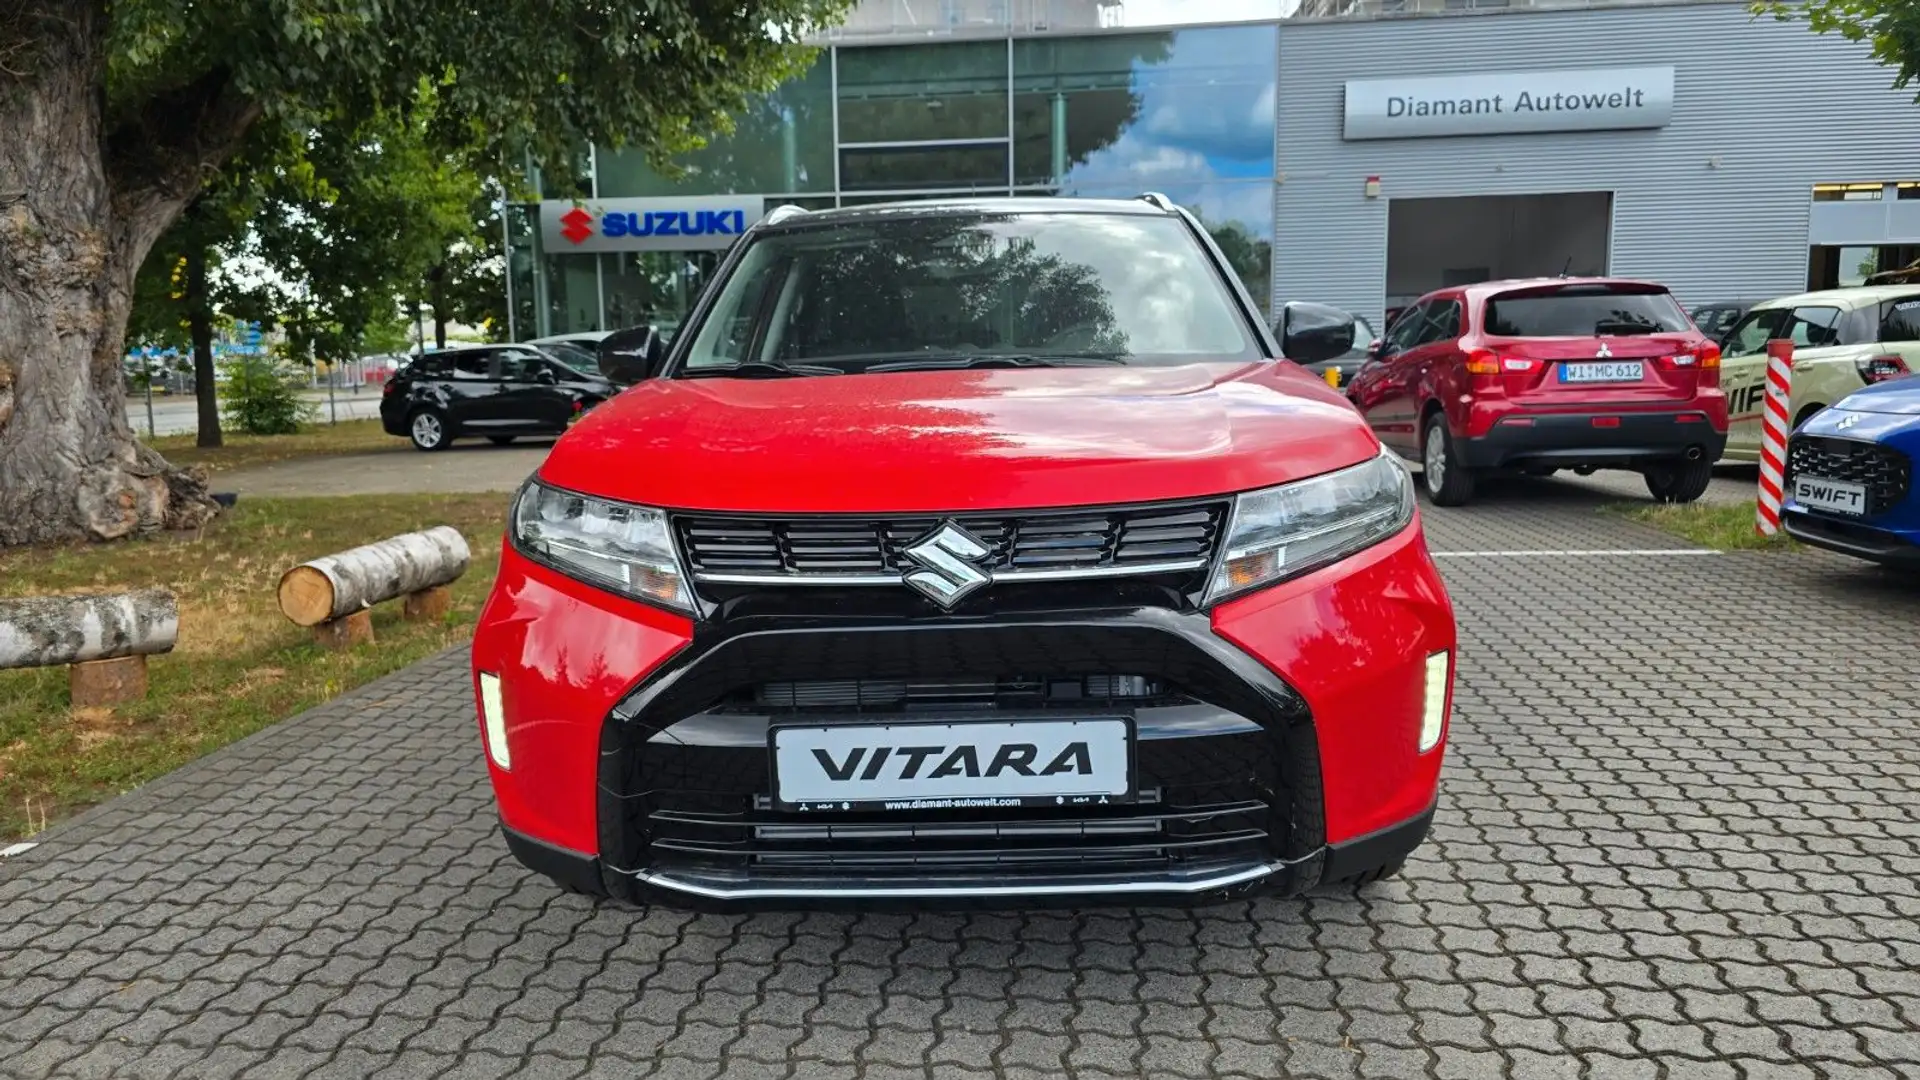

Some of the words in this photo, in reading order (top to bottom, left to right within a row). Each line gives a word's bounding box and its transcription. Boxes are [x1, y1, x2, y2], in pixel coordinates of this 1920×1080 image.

[1387, 95, 1503, 117] Diamant
[1513, 86, 1644, 113] Autowelt
[602, 209, 744, 237] SUZUKI
[1568, 365, 1585, 378] WI
[1595, 365, 1613, 377] MC
[1616, 364, 1641, 377] 612
[1798, 483, 1862, 506] SWIFT
[810, 741, 1093, 781] VITARA
[885, 797, 1021, 810] www.diamant-autowelt.com
